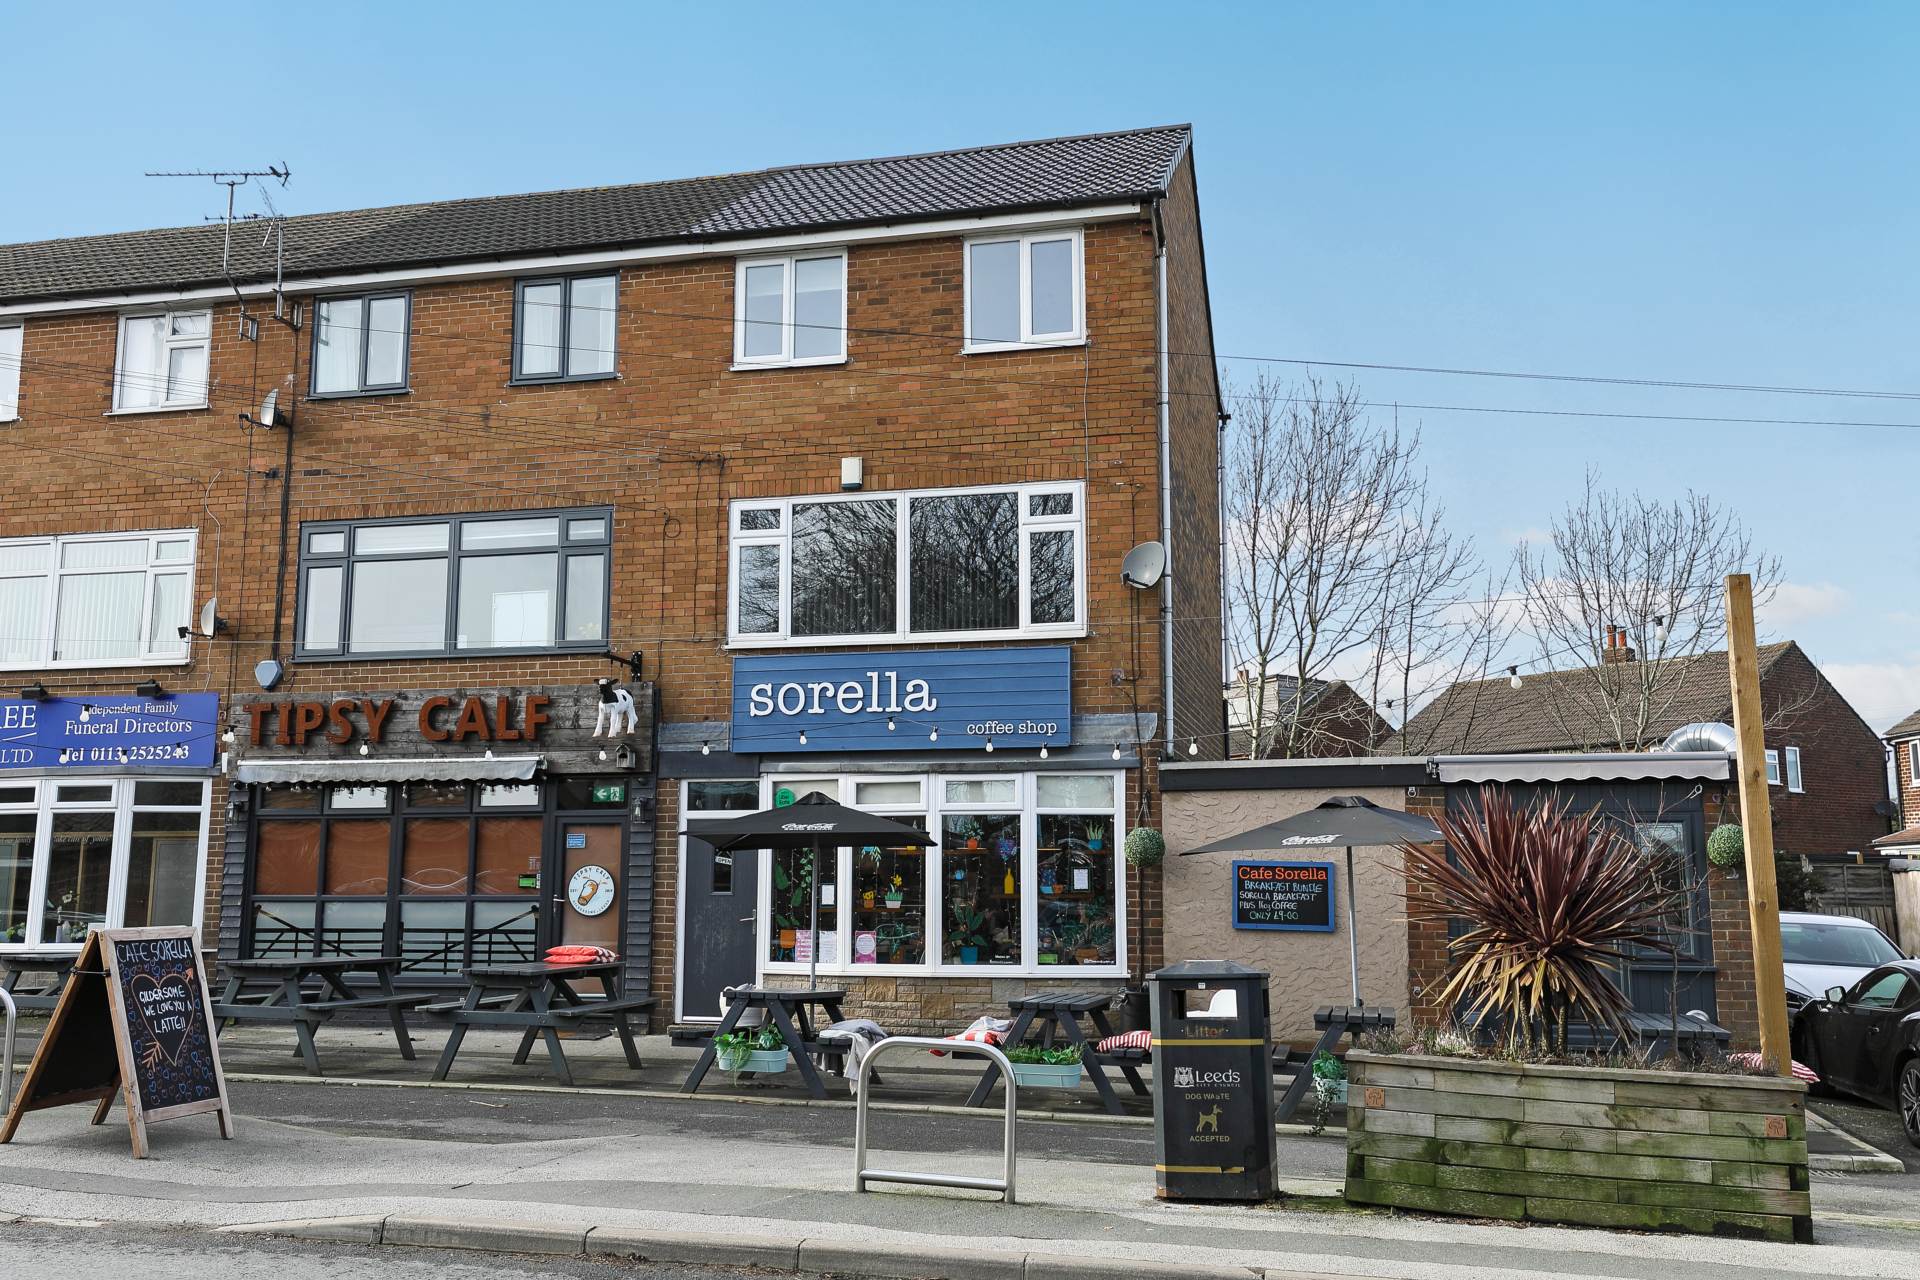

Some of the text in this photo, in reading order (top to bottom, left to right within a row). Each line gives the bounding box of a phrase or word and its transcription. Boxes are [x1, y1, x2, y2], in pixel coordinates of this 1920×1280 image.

[750, 671, 937, 717] sorella
[144, 701, 179, 716] Family
[0, 705, 37, 729] EE
[242, 695, 550, 745] TIPSY CALF
[65, 718, 193, 735] Funeral Directors
[967, 720, 1057, 736] coffee shop
[0, 748, 34, 763] LTD
[66, 747, 85, 761] Tel
[91, 746, 123, 761] 0113
[1239, 866, 1327, 880] Cafe Sorella
[1244, 880, 1290, 892] BREAKFAST
[1239, 890, 1318, 901] SORELLA BREAKFAST
[1271, 901, 1298, 910] COFFEE
[1249, 911, 1271, 920] ONLY
[116, 939, 193, 962] CAFE SORELLA
[143, 1004, 156, 1016] WE
[157, 1000, 174, 1014] LOVE
[173, 1000, 185, 1012] YOU
[1196, 1069, 1240, 1083] Leeds
[1190, 1135, 1230, 1143] ACCEPTED
